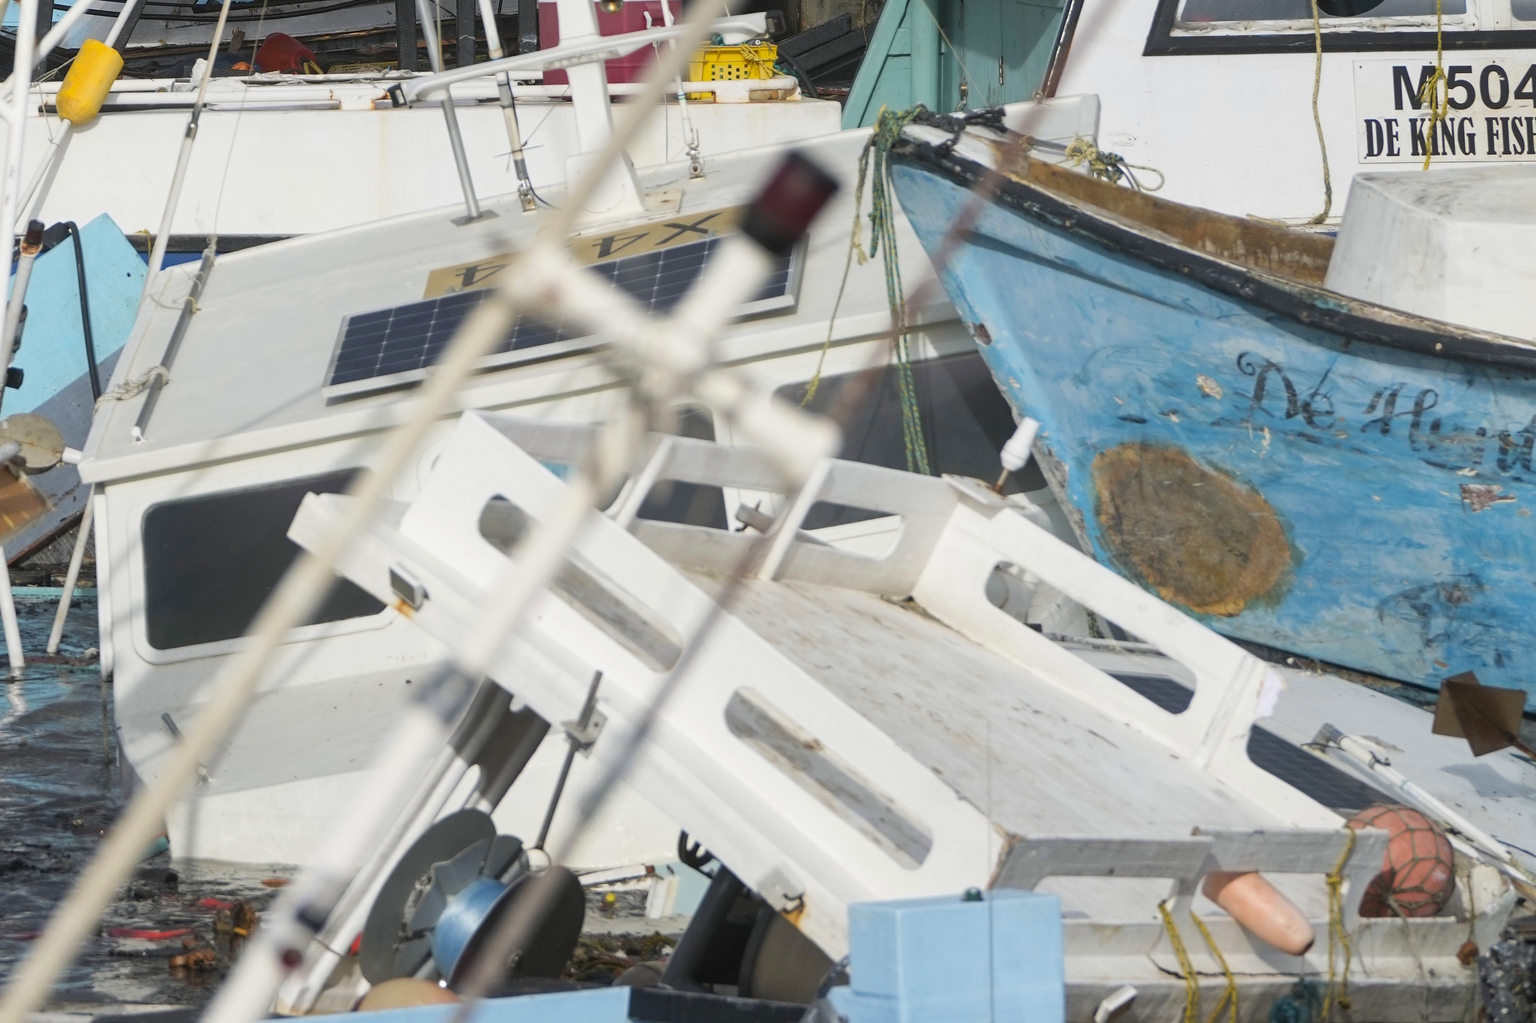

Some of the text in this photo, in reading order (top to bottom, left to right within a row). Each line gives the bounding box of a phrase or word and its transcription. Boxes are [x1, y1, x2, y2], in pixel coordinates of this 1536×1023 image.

[1392, 64, 1536, 111] M504
[1364, 117, 1401, 158] DE
[1408, 116, 1476, 157] KING
